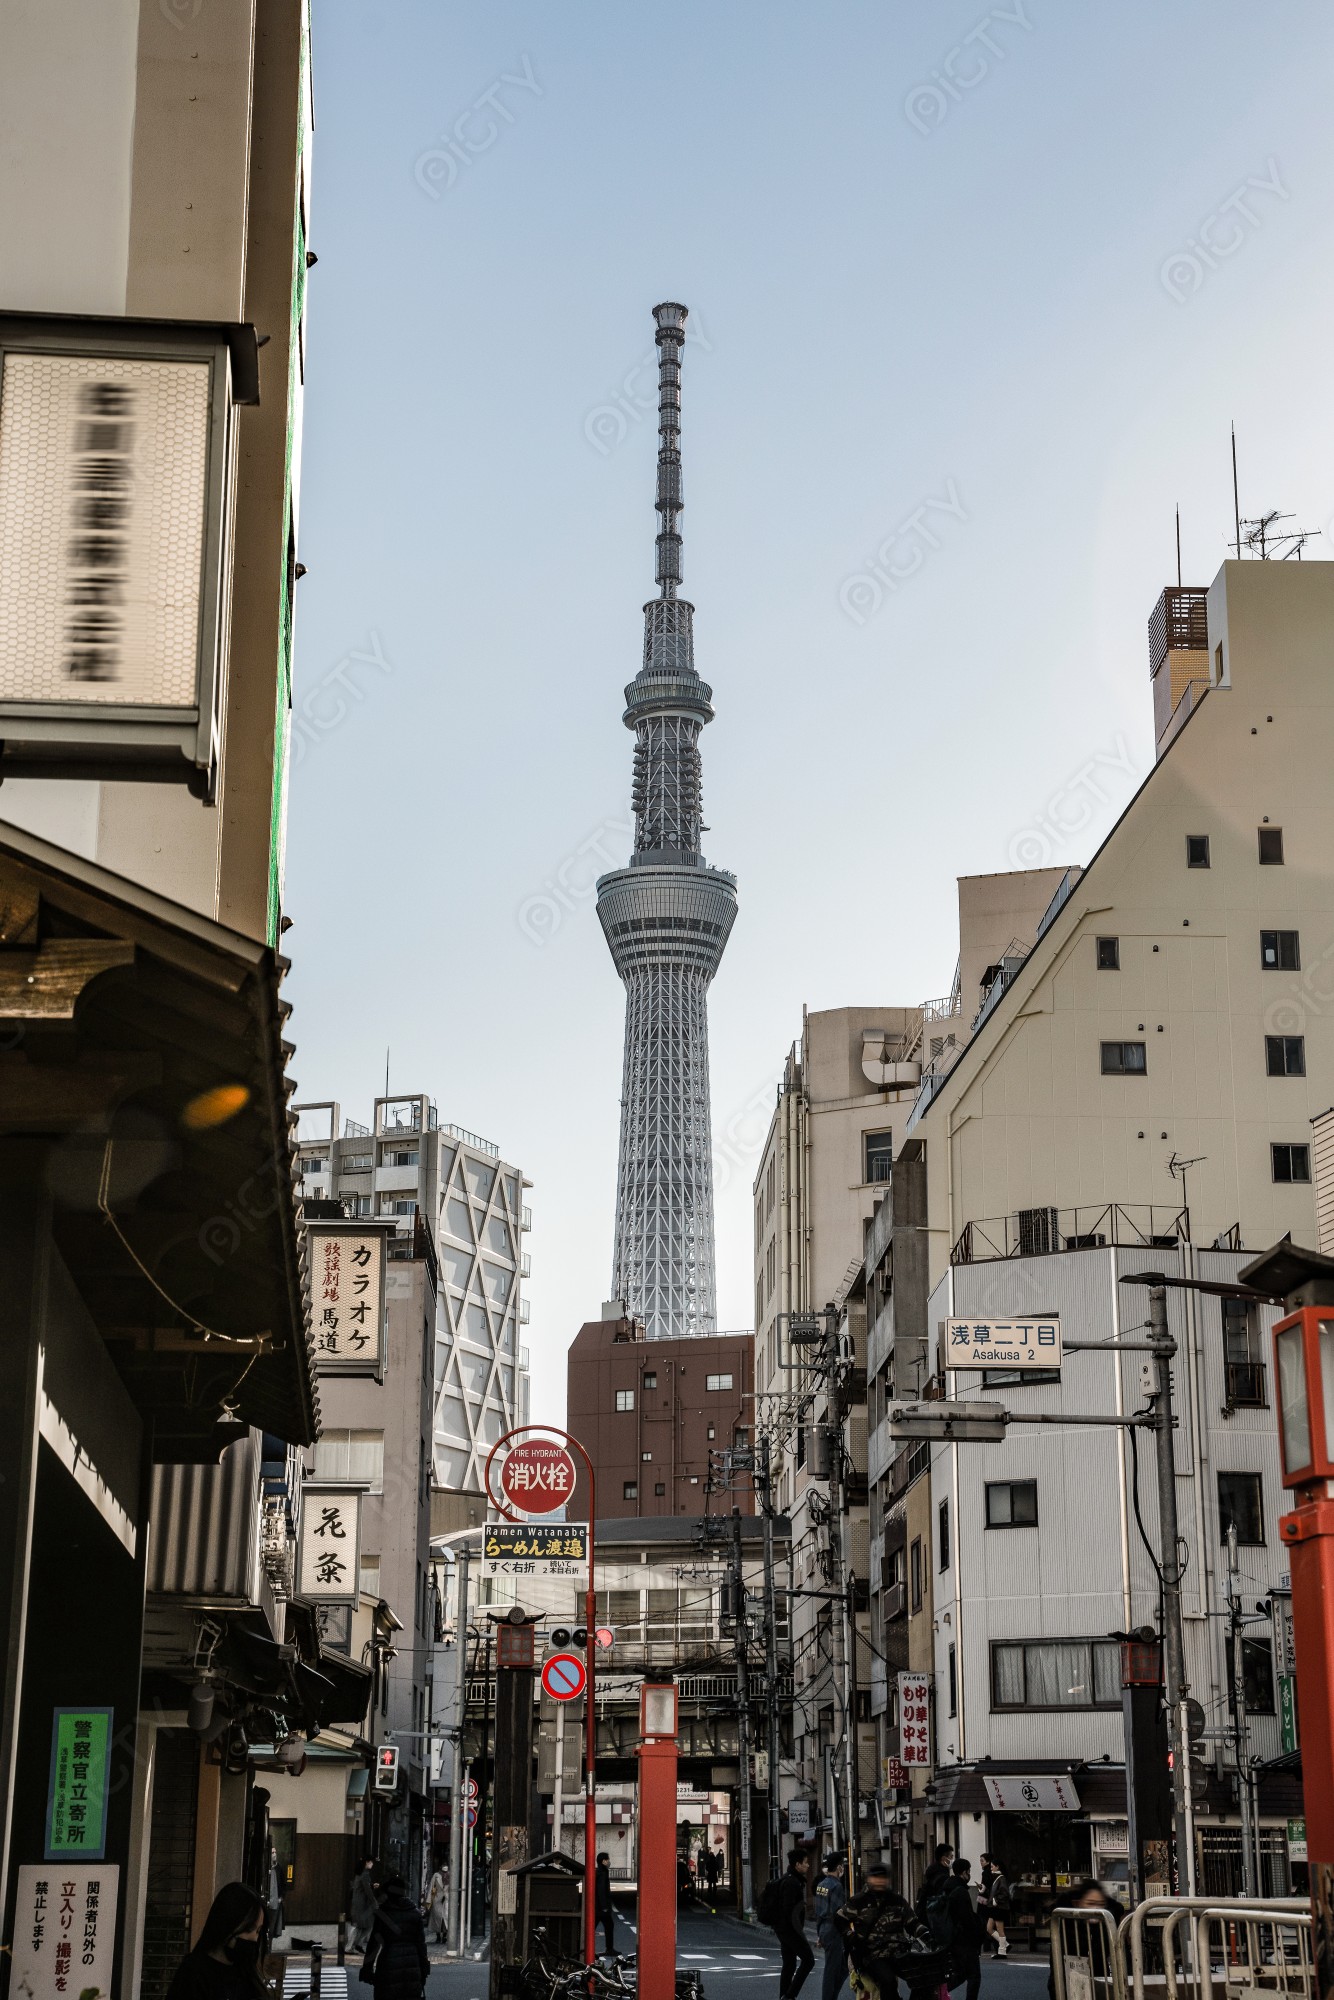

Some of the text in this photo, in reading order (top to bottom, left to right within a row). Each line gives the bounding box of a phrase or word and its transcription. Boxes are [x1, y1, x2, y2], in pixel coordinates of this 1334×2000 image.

[348, 1245, 372, 1351] カラオケ
[318, 1307, 342, 1354] 馬道
[951, 1325, 1055, 1346] 浅草二丁目
[972, 1349, 1035, 1360] Asakusa 2
[514, 1449, 563, 1458] FIRE HYDRANT
[508, 1462, 570, 1491] 消火栓
[486, 1527, 585, 1537] Ramen Watanabe
[488, 1562, 536, 1573] すぐ右折
[549, 1560, 572, 1568] 続いて
[903, 1686, 916, 1764] もり中華
[915, 1685, 928, 1763] 中華そば
[67, 1720, 93, 1844] 警察官立寄所
[890, 1769, 904, 1777] コイン
[31, 1881, 49, 1952] 禁止します
[82, 1881, 100, 1965] 関係者以外の
[54, 1881, 77, 1992] 立入り・撮影を
